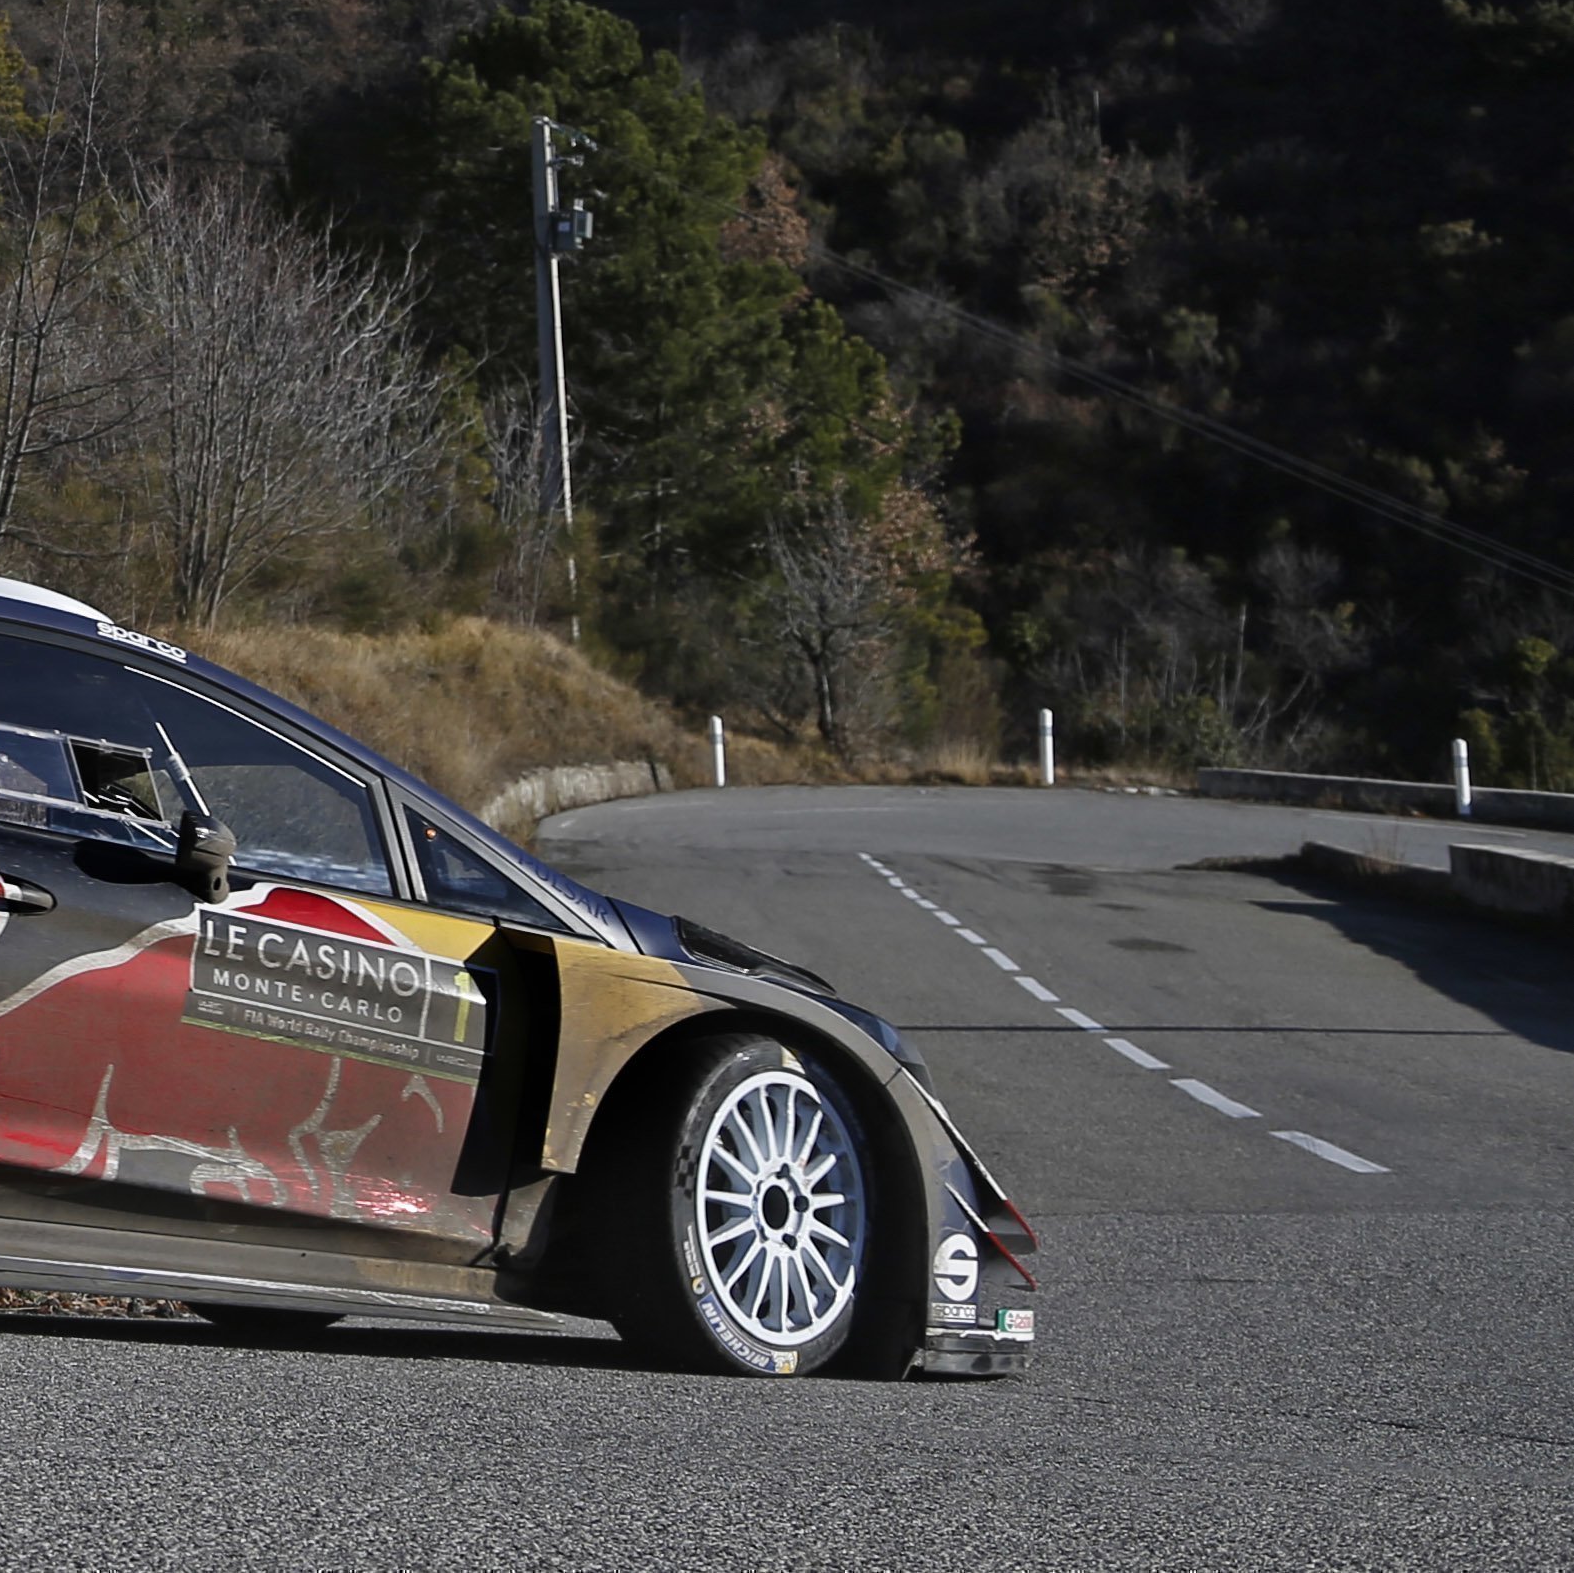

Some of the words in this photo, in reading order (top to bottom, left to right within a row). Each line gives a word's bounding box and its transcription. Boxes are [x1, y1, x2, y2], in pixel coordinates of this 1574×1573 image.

[98, 622, 186, 660] sparco
[204, 919, 247, 961] LE
[258, 932, 419, 997] CASINO
[453, 971, 474, 1043] 1
[703, 1302, 771, 1368] MICHELIN
